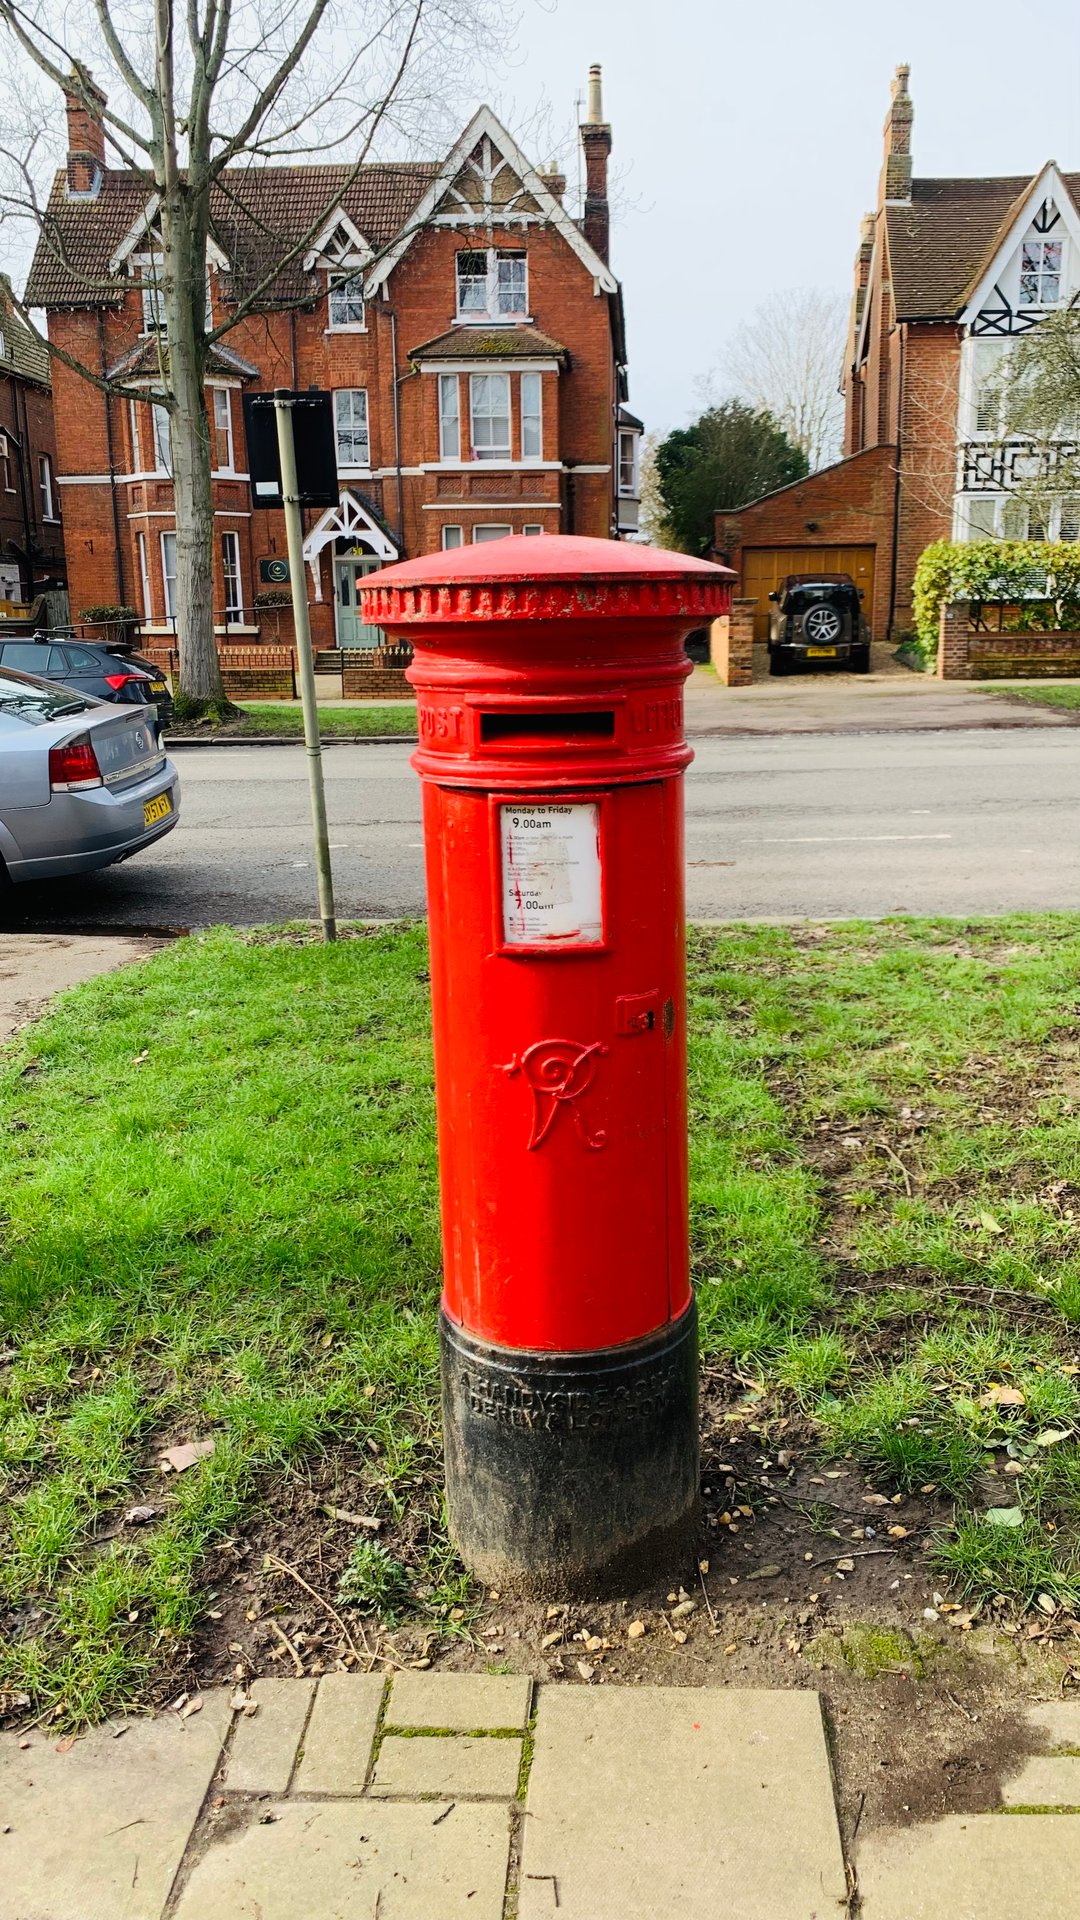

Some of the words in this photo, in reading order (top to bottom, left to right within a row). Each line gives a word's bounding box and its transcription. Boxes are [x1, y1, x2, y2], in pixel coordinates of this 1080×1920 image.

[351, 546, 363, 556] 50
[419, 705, 465, 740] POST
[505, 806, 536, 815] Monday
[548, 806, 573, 815] Friday
[512, 817, 552, 828] 9.00am
[508, 888, 543, 897] Surday
[515, 899, 554, 910] 7.00am
